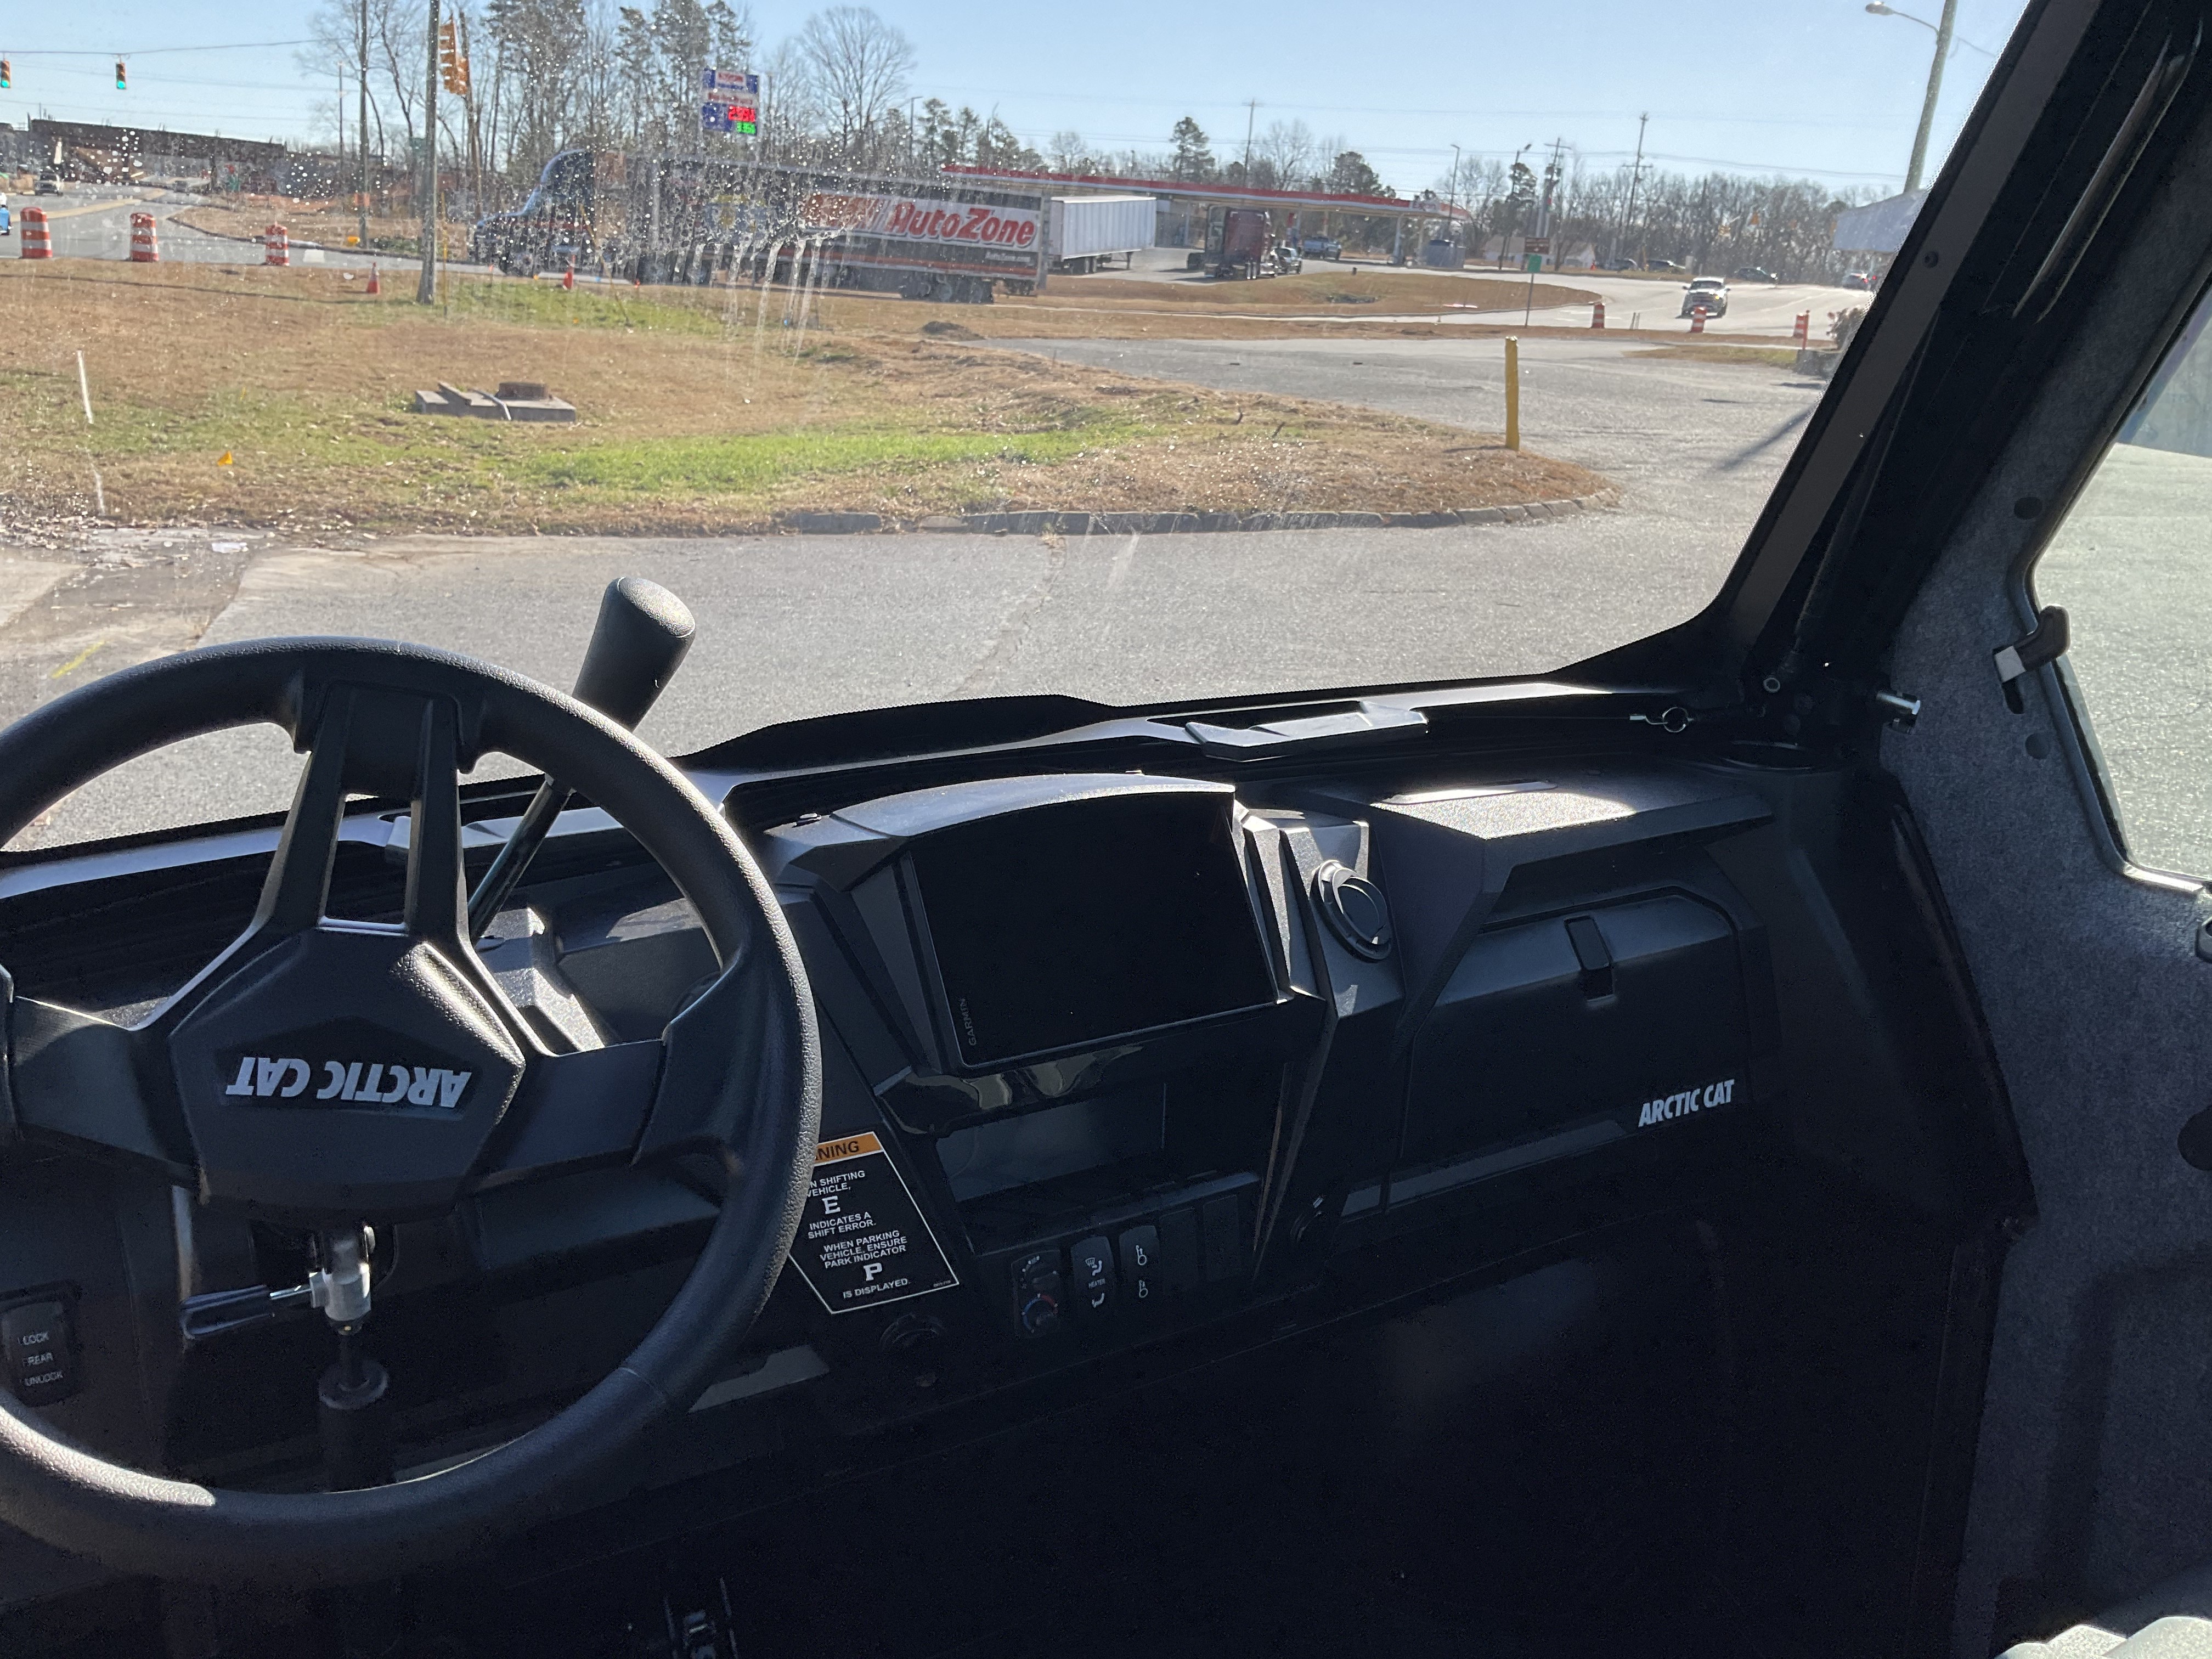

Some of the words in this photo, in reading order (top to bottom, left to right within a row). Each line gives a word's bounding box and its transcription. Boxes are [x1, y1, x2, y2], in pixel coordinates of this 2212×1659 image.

[884, 202, 1035, 246] AutoZone
[958, 997, 977, 1046] GARMIN
[225, 1057, 312, 1098] CAT
[316, 1060, 472, 1108] ARCTIC
[1638, 1088, 1701, 1128] ARCTIC
[1703, 1079, 1735, 1108] CAT
[815, 1141, 860, 1160] NING
[820, 1170, 866, 1187] SHIFTING
[821, 1195, 841, 1215] E
[807, 1227, 836, 1239] SHIFT
[838, 1219, 877, 1234] ERROR.
[809, 1212, 862, 1231] INDICATES
[863, 1211, 871, 1220] A
[823, 1240, 854, 1253] WHEN
[856, 1229, 900, 1246] PARKING
[867, 1235, 908, 1252] ENSURE
[825, 1257, 853, 1269] PARK
[854, 1244, 907, 1263] INDICATOR
[863, 1262, 883, 1281] P
[843, 1290, 853, 1299] IS
[18, 1331, 49, 1346] LOCK
[22, 1352, 54, 1367] REAR
[23, 1370, 64, 1387] UNLOCK
